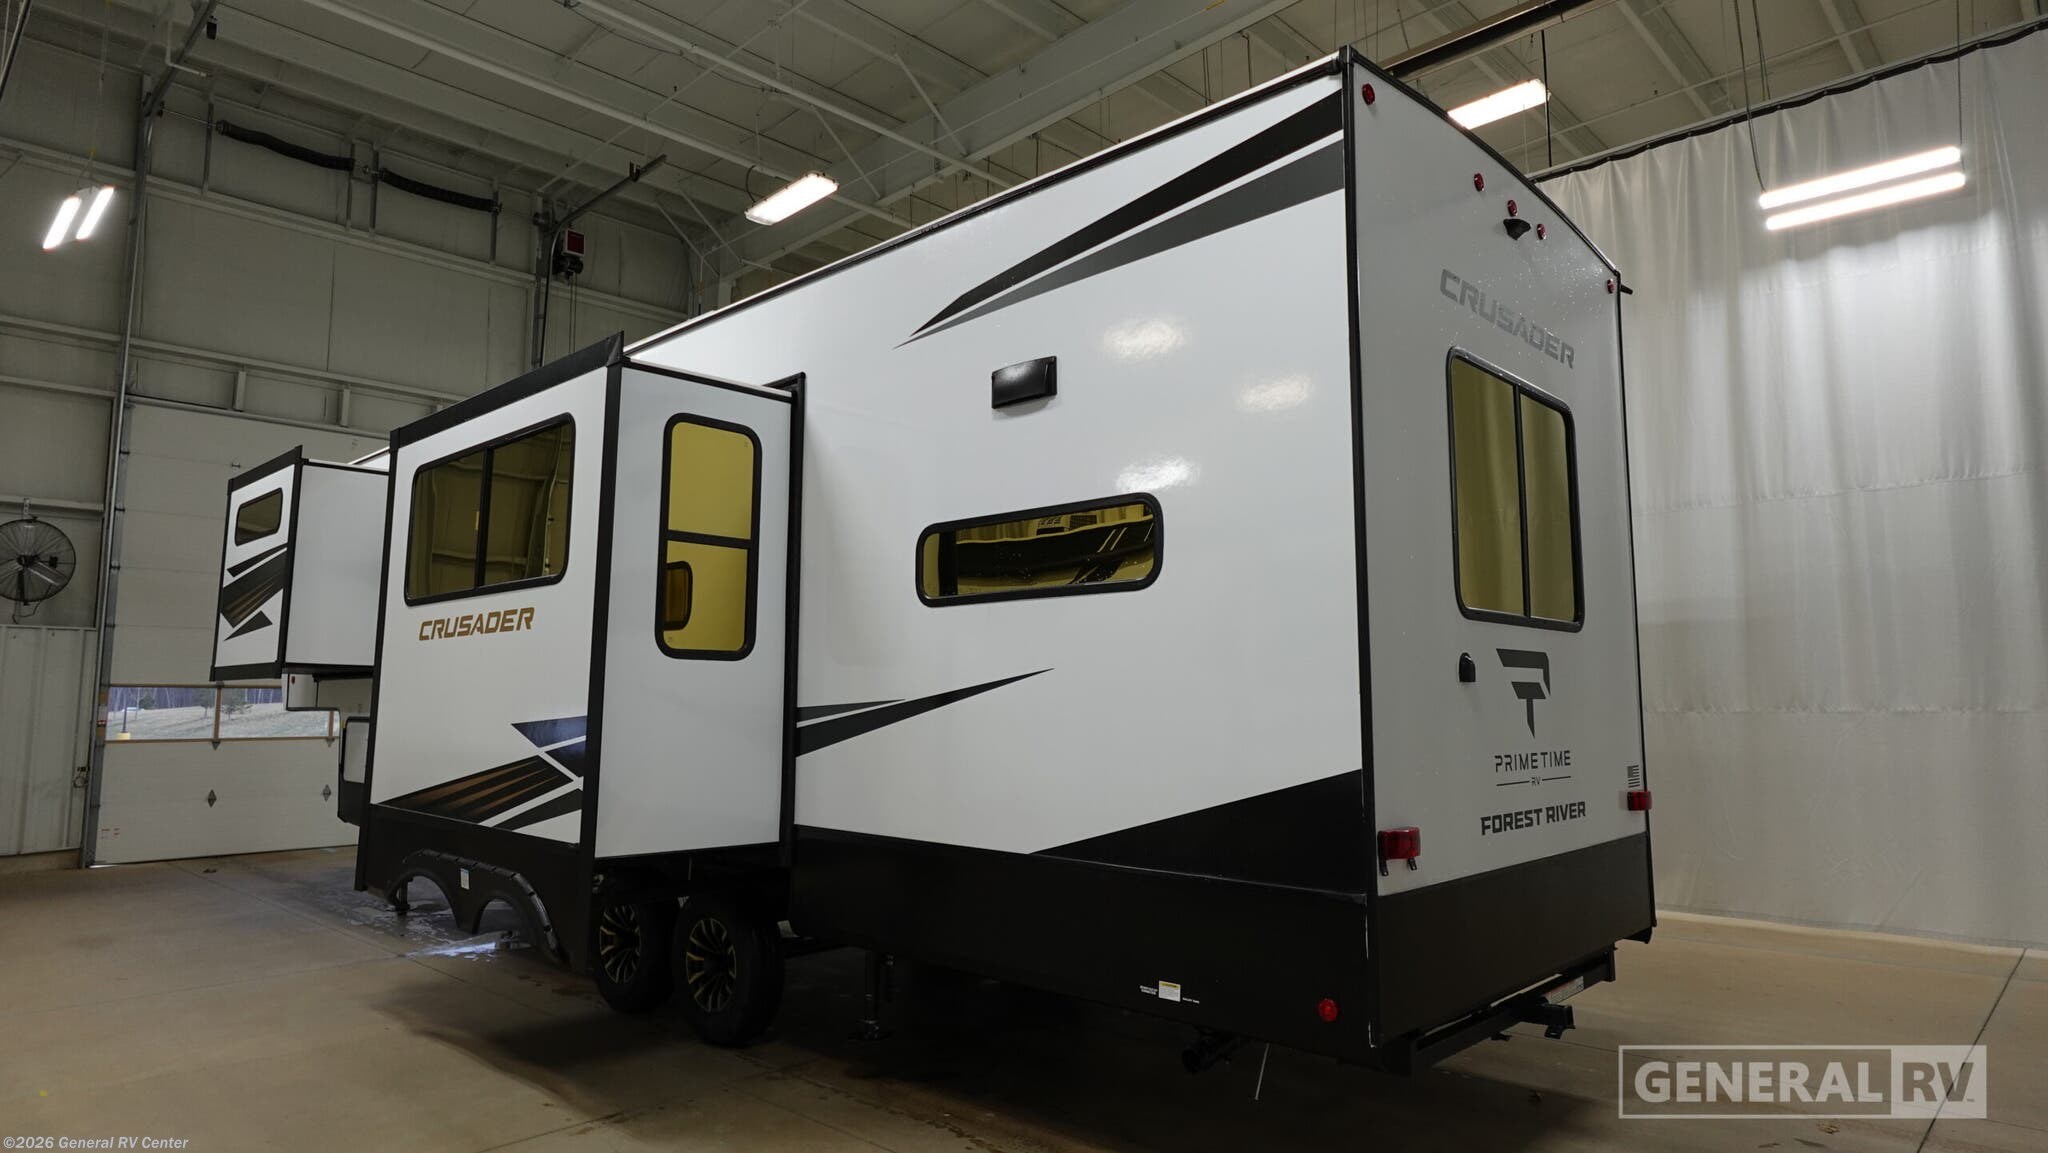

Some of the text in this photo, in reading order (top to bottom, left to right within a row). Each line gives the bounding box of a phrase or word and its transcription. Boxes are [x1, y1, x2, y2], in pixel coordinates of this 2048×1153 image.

[1440, 268, 1575, 369] CRUSADER
[419, 606, 535, 641] CRUSADER
[1531, 776, 1541, 786] RV
[1480, 801, 1586, 836] FOREST RIVER
